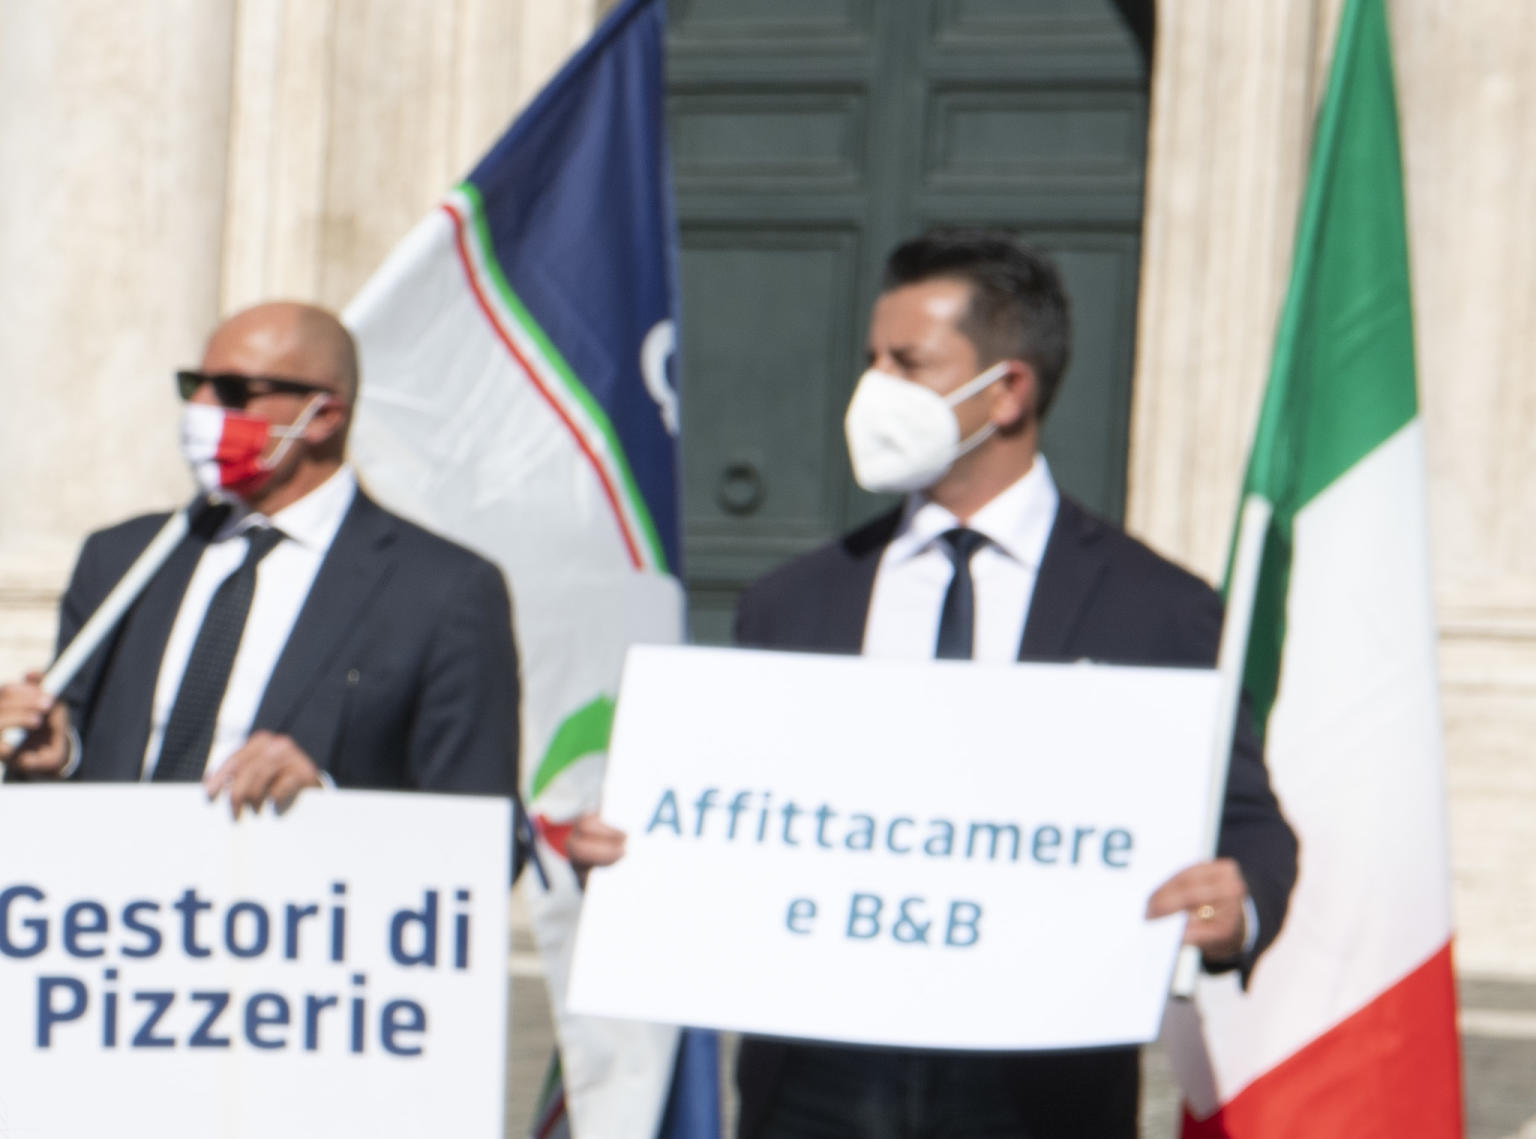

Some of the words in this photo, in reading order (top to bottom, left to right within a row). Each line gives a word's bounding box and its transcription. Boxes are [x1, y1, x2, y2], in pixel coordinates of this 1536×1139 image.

[645, 786, 1135, 870] Affittacamere
[387, 888, 472, 970] di
[784, 894, 819, 936] e
[845, 891, 986, 950] B&B
[34, 966, 429, 1057] Pizzerie
